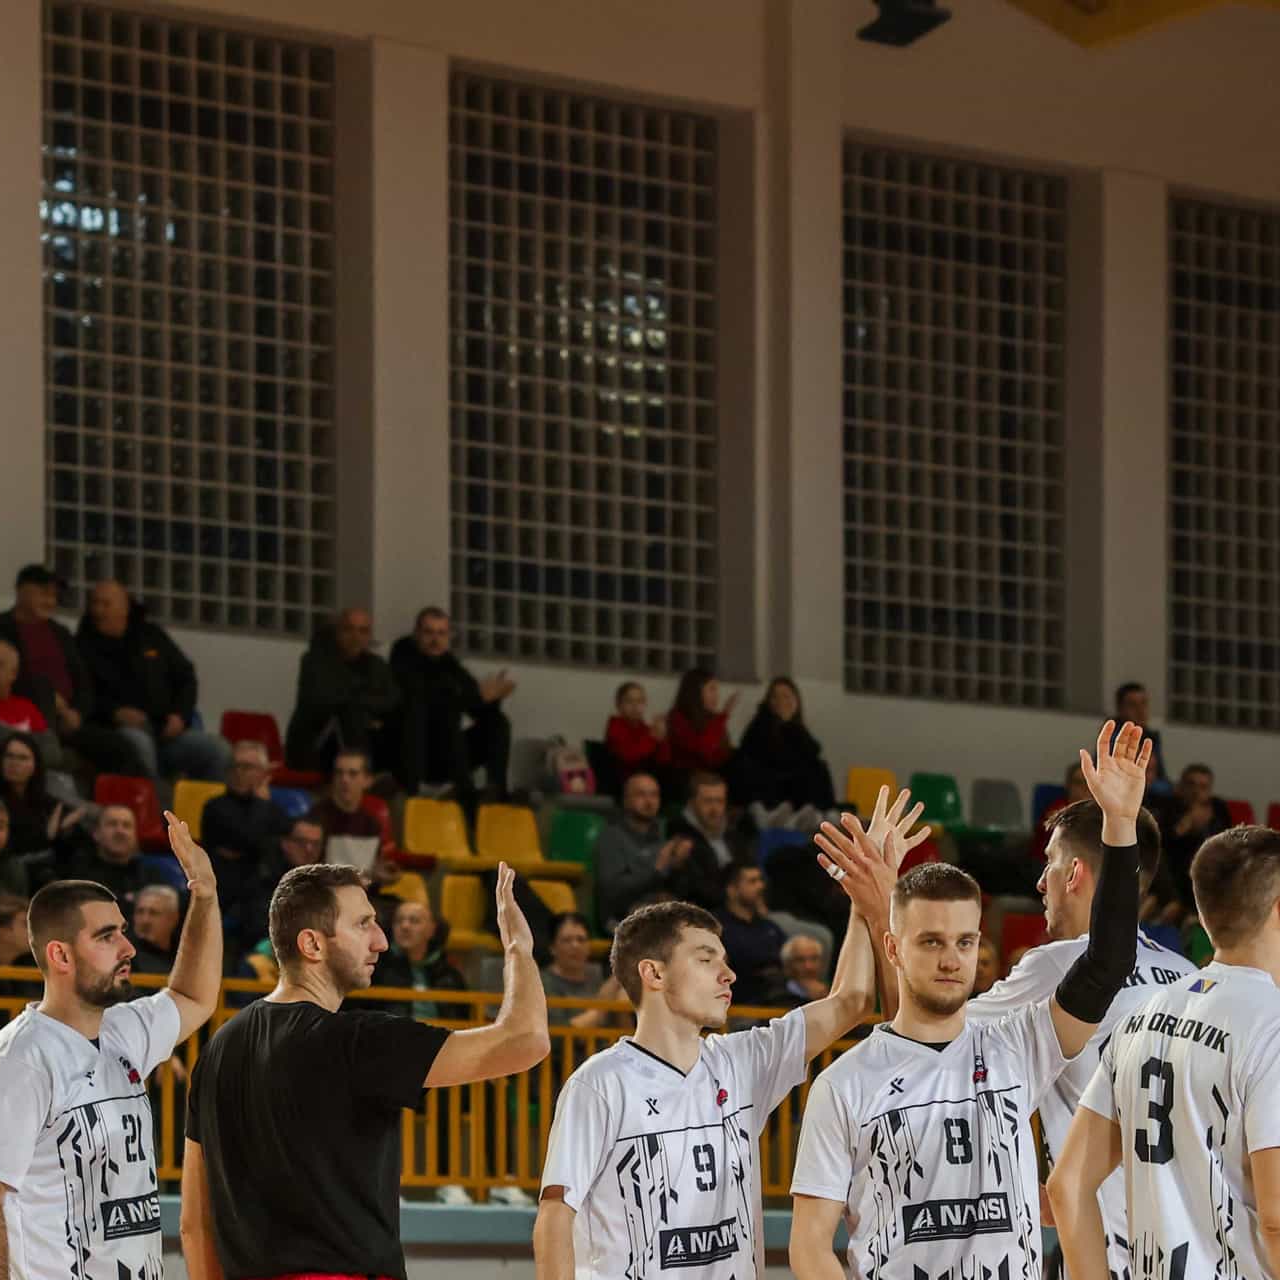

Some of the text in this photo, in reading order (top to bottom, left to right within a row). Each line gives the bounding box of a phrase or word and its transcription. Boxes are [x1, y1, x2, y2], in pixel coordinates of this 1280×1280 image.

[1148, 1013, 1230, 1053] ORLOVIK
[1135, 1057, 1174, 1164] 3
[122, 1114, 146, 1163] 21
[944, 1118, 973, 1165] 8
[693, 1144, 717, 1192] 9
